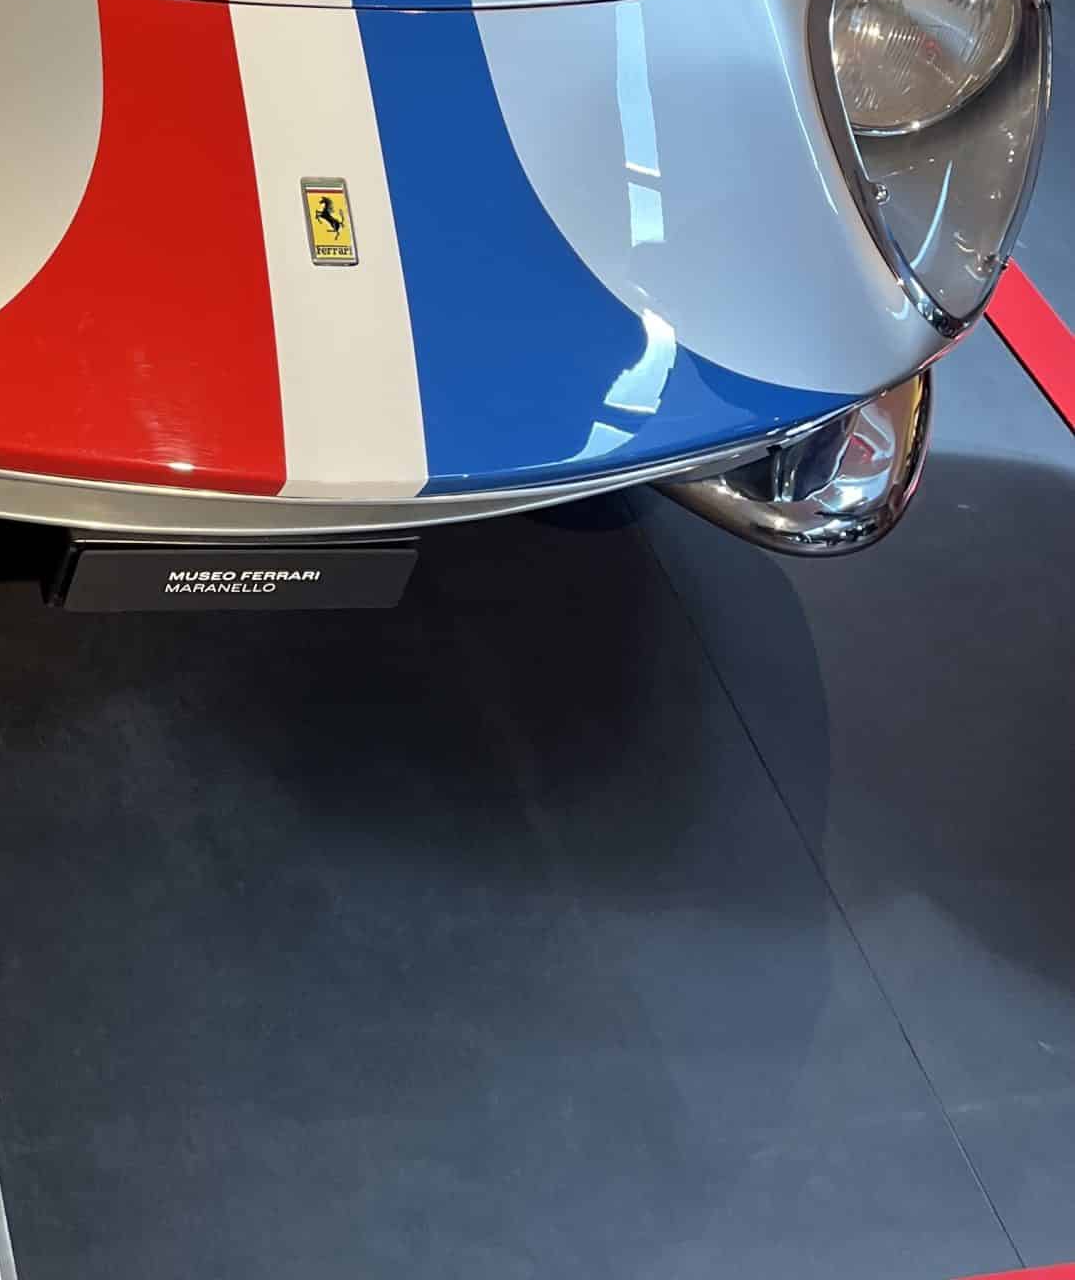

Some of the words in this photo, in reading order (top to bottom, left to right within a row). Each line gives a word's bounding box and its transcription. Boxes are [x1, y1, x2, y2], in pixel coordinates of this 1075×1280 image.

[168, 570, 236, 582] MUSEO
[240, 570, 321, 582] FERRARI
[164, 582, 277, 593] MARANELLO
